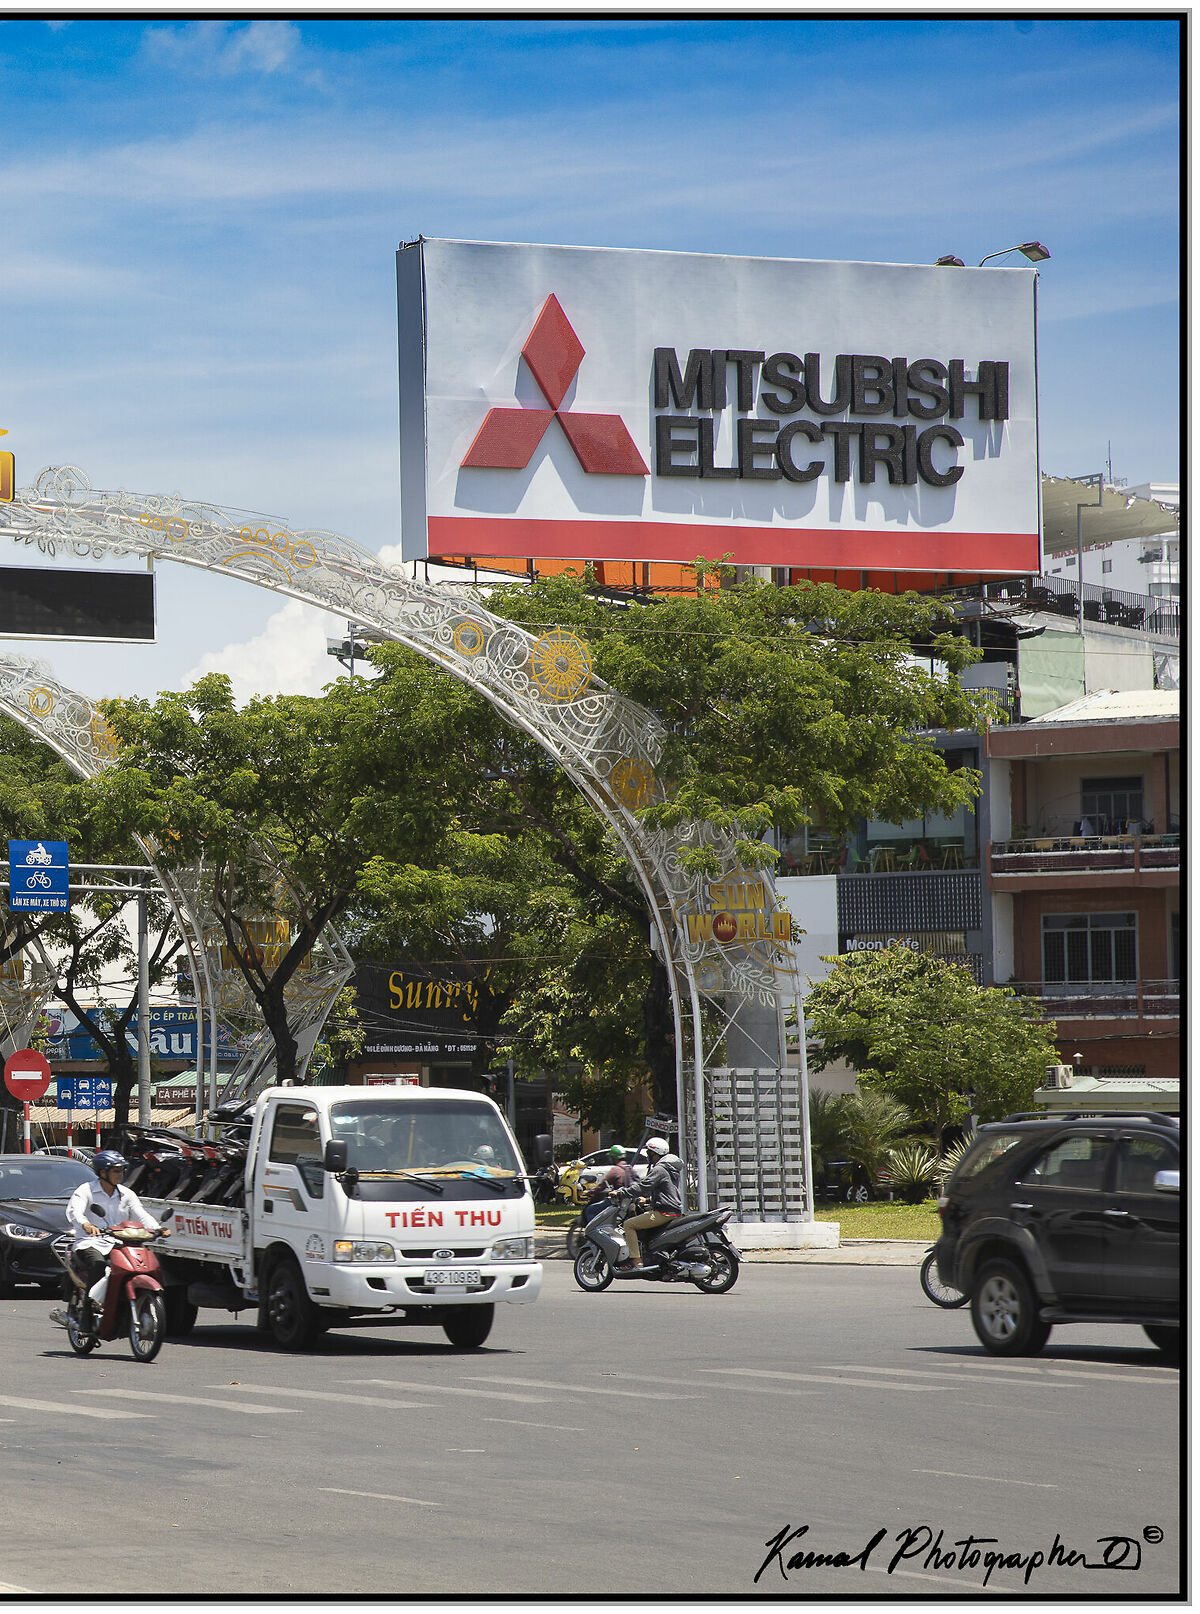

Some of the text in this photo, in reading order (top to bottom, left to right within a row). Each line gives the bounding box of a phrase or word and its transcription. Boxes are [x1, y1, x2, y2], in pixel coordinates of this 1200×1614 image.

[654, 347, 1009, 421] MITSUBISHI
[655, 414, 965, 487] ELECTRIC
[12, 896, 22, 906] LÀN
[22, 897, 30, 906] XE
[43, 898, 50, 907] XE
[704, 882, 766, 911] SUN
[681, 911, 792, 945] WORLD
[846, 939, 882, 951] Moon
[163, 1010, 175, 1021] ÉP
[106, 1026, 193, 1054] âu
[158, 1087, 171, 1099] CÀ
[172, 1087, 189, 1099] PHÊ
[186, 1214, 233, 1239] TIẾN THU
[385, 1205, 502, 1228] TIẾN THU
[426, 1271, 480, 1284] 43C-109.63
